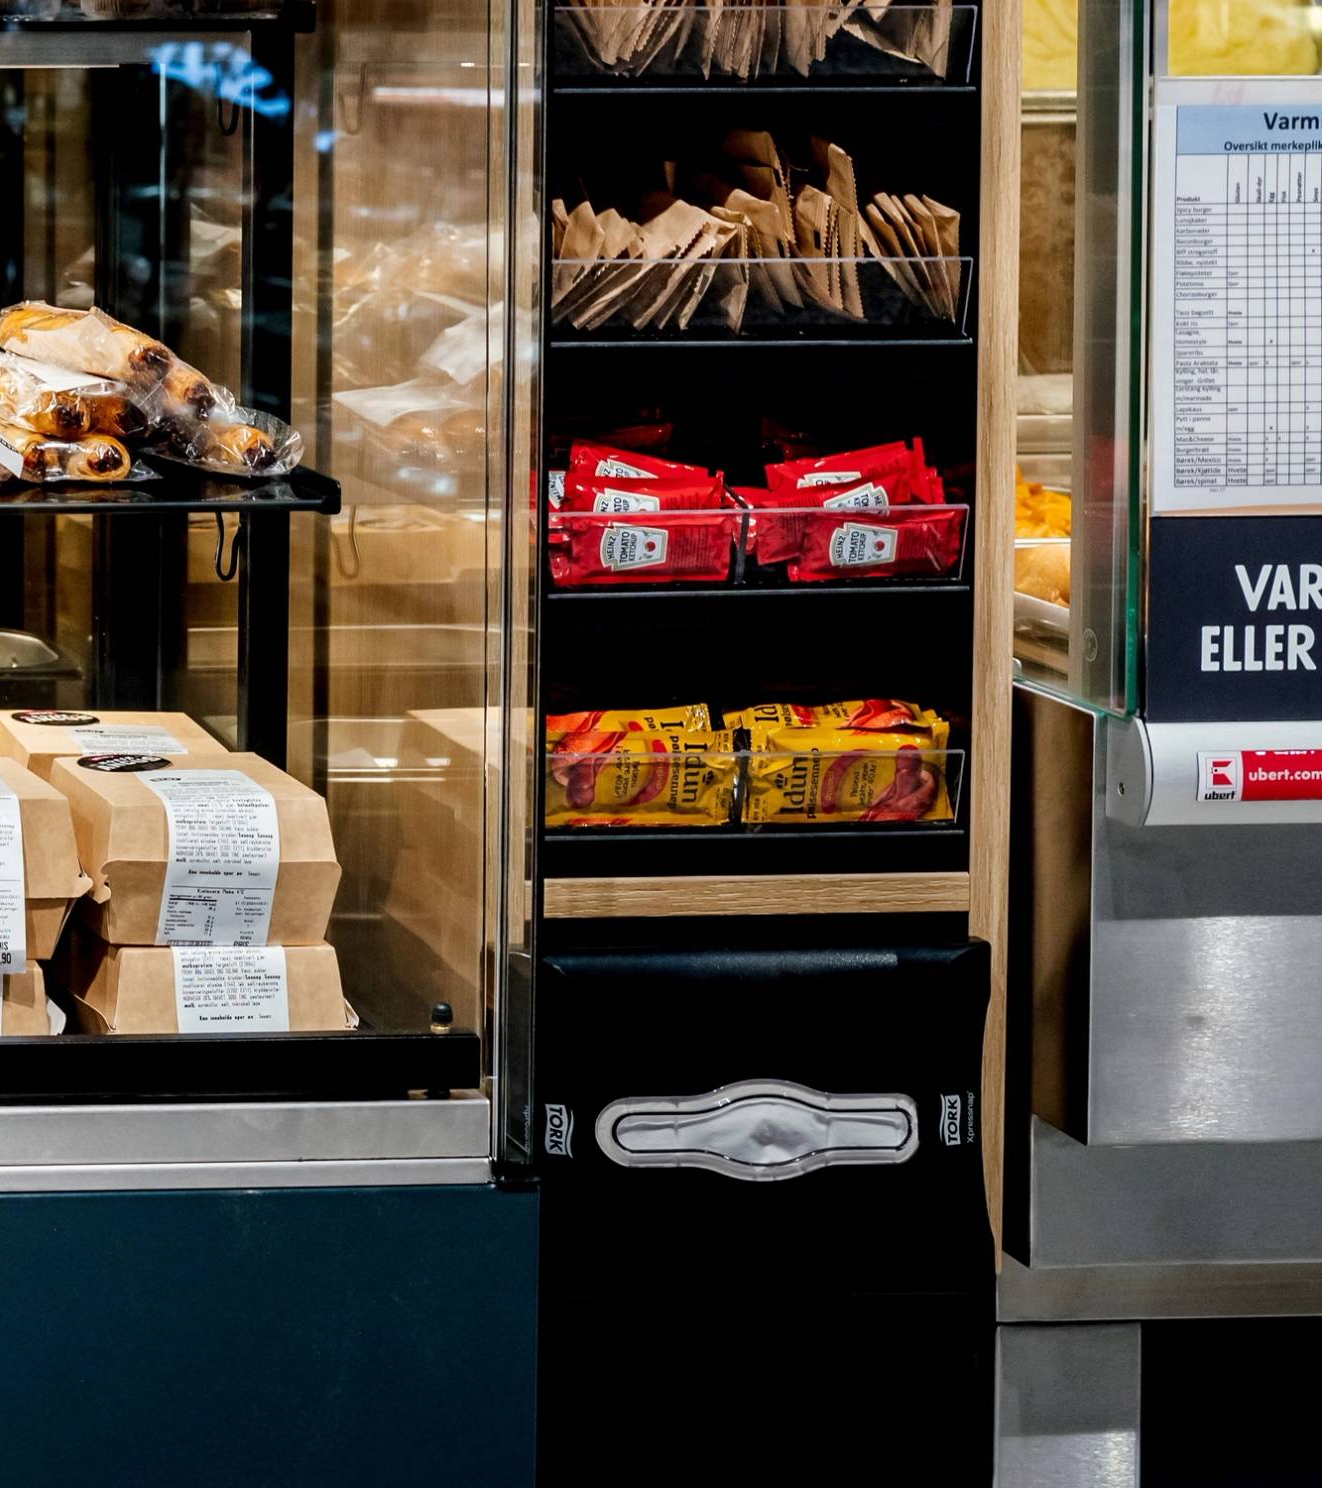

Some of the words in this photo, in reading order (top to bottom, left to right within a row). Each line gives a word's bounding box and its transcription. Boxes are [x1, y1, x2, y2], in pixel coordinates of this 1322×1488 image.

[1224, 141, 1268, 151] Oversikt
[607, 536, 616, 560] HEINZ
[619, 531, 630, 563] TOMATO
[629, 533, 637, 561] KETCHUP
[836, 536, 845, 560] HEINZ
[849, 531, 860, 563] TOMATO
[858, 533, 866, 561] KETCHUP
[1201, 624, 1316, 671] ELLER
[682, 742, 708, 804] Idun
[780, 756, 808, 814] Idun
[1204, 791, 1236, 800] ubert
[549, 1107, 563, 1152] TORK
[948, 1098, 957, 1143] TORK
[967, 1092, 975, 1143] Xpressnap
